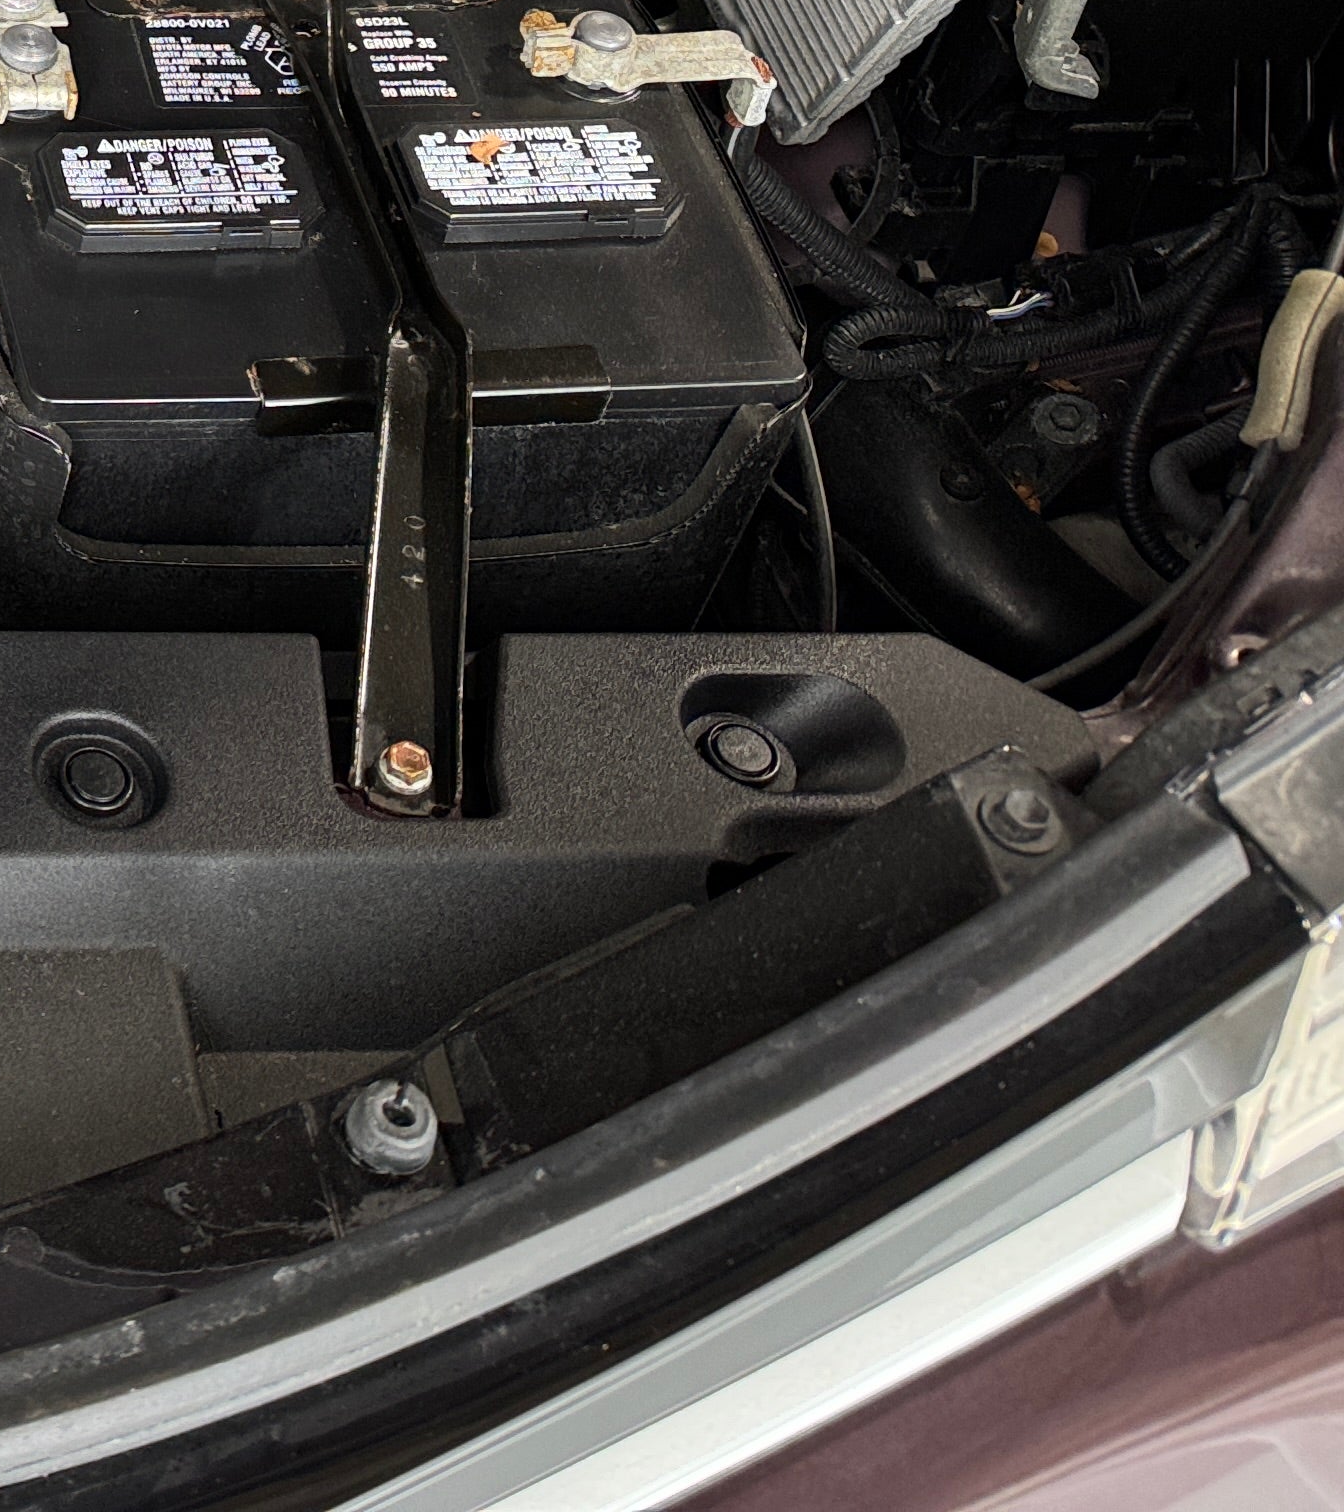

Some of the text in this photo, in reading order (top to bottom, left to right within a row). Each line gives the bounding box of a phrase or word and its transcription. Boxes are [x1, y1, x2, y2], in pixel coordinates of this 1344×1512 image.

[146, 19, 230, 28] 28800-0V021
[356, 17, 409, 27] 65D23L
[254, 31, 271, 52] LEAD
[363, 38, 414, 50] GROUP
[416, 38, 437, 49] 35
[372, 62, 435, 72] 550 AMPS
[381, 87, 458, 98] 90 MINUTES
[113, 138, 213, 153] DANGER/POISON
[104, 199, 120, 207] OUT
[122, 198, 134, 207] OF
[134, 198, 152, 207] THE
[153, 198, 180, 207] REACH
[182, 198, 193, 206] OF
[163, 206, 185, 215] CAPS
